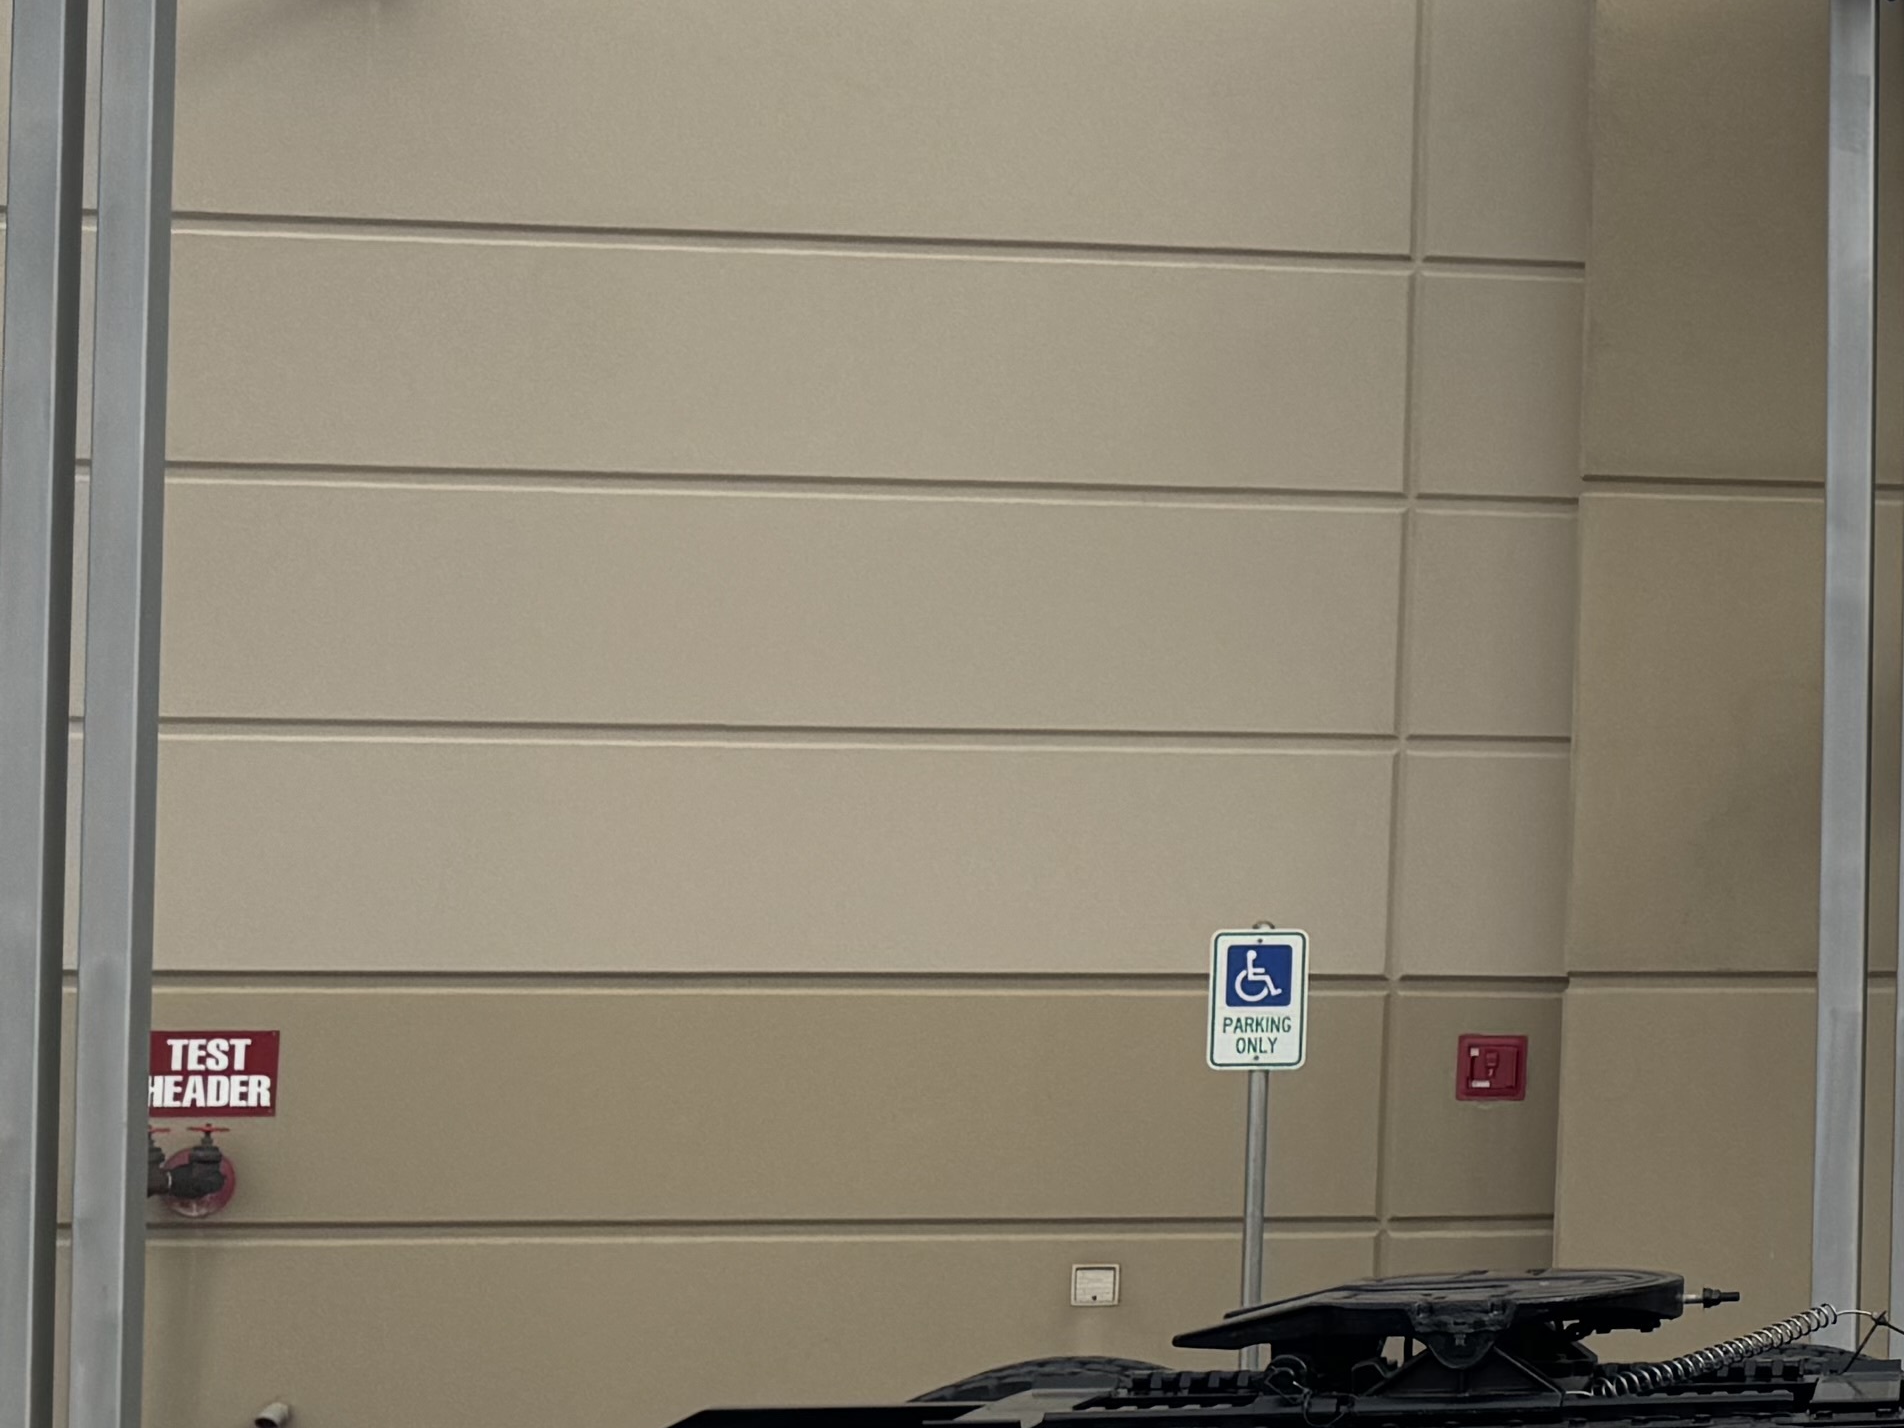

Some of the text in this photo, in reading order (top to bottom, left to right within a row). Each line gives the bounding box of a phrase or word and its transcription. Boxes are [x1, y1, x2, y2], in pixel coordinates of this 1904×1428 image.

[1222, 1016, 1292, 1034] PARKING
[166, 1038, 252, 1071] TEST
[1235, 1037, 1278, 1054] ONLY
[148, 1075, 271, 1108] HEADER
